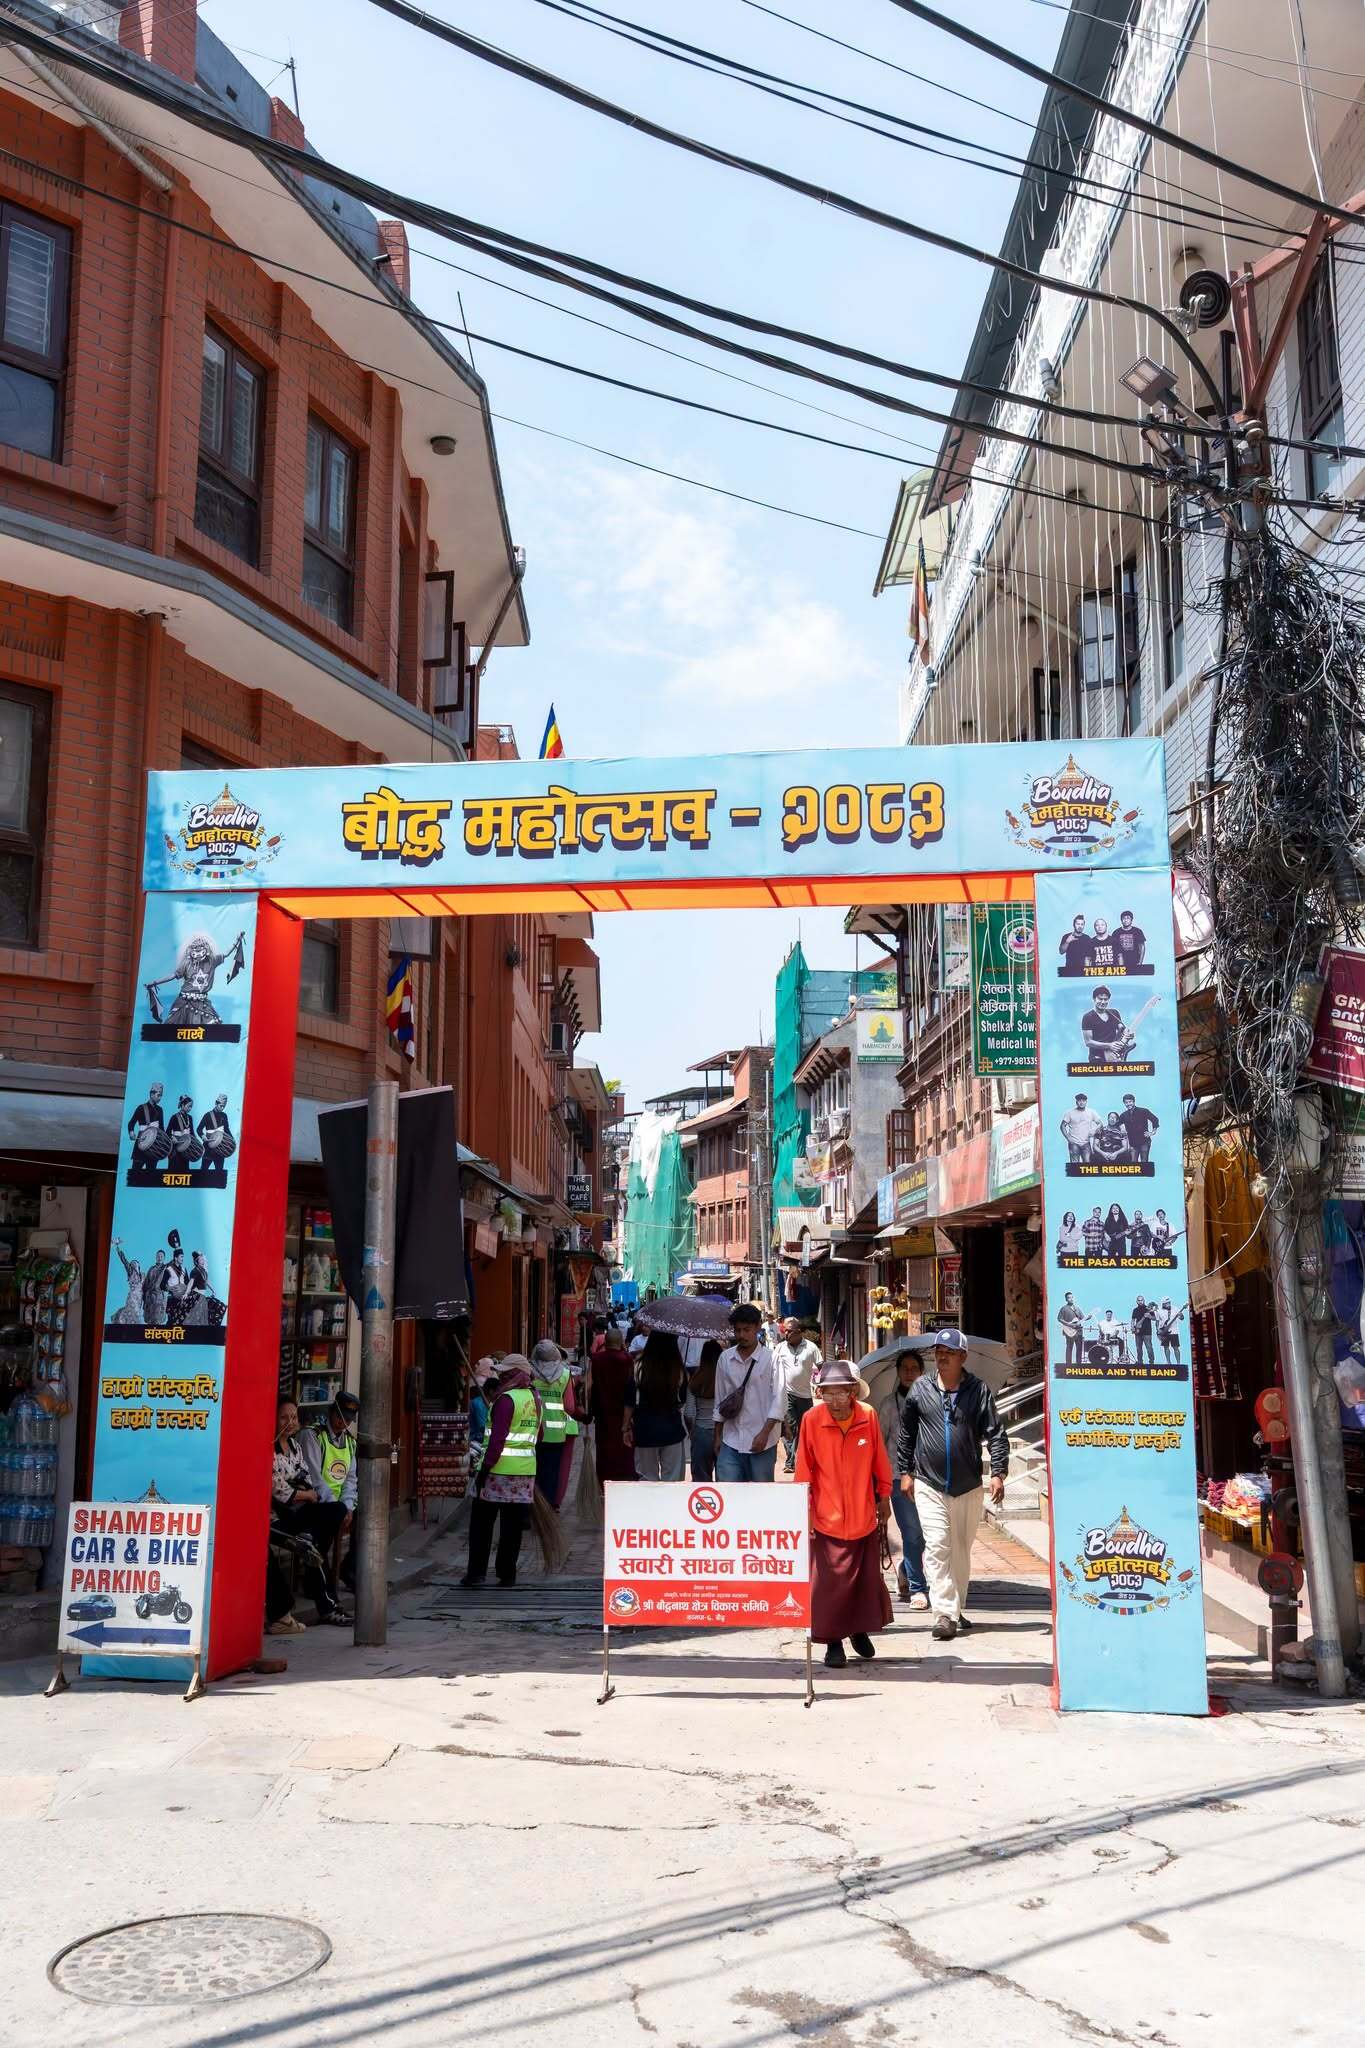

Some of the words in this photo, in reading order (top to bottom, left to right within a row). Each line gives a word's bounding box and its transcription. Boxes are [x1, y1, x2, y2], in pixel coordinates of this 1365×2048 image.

[1031, 777, 1112, 803] Boudha
[189, 803, 259, 828] Boudha
[463, 785, 717, 855] महोत्सव
[781, 781, 945, 848] २०८३
[1094, 945, 1113, 954] THE
[1083, 967, 1104, 976] THE
[1105, 966, 1127, 976] AXE
[1331, 1008, 1364, 1023] and
[176, 1027, 205, 1040] लाखे
[981, 1020, 1013, 1032] Shelkar
[1017, 1020, 1036, 1032] Sow
[987, 1037, 1022, 1049] Medical
[1345, 1031, 1365, 1043] Roo
[1071, 1065, 1114, 1074] HERCULES
[1116, 1064, 1151, 1073] BASNET
[1079, 1165, 1099, 1174] THE
[1101, 1165, 1142, 1174] RENDER
[162, 1173, 192, 1186] बाजा
[1063, 1257, 1085, 1267] THE
[1087, 1257, 1117, 1267] PASA
[1120, 1257, 1171, 1267] ROCKERS
[144, 1327, 186, 1344] संस्कृति
[1066, 1368, 1104, 1377] PHURBA
[1107, 1368, 1127, 1377] AND
[1129, 1368, 1148, 1377] THE
[1150, 1368, 1177, 1377] BAND
[102, 1375, 145, 1399] हाम्रो
[111, 1405, 153, 1430] हाम्रो
[156, 1407, 209, 1429] उत्सव
[73, 1509, 203, 1537] SHAMBHU
[612, 1528, 695, 1549] VEHICLE
[702, 1530, 730, 1549] NO
[737, 1529, 802, 1550] ENTRY
[1086, 1527, 1166, 1557] Boudha
[70, 1536, 116, 1563] CAR
[123, 1538, 140, 1564] &
[147, 1538, 199, 1565] BIKE
[619, 1554, 674, 1575] सवारी
[681, 1558, 736, 1575] साधन
[742, 1554, 794, 1576] निषेध
[70, 1568, 161, 1594] PARKING
